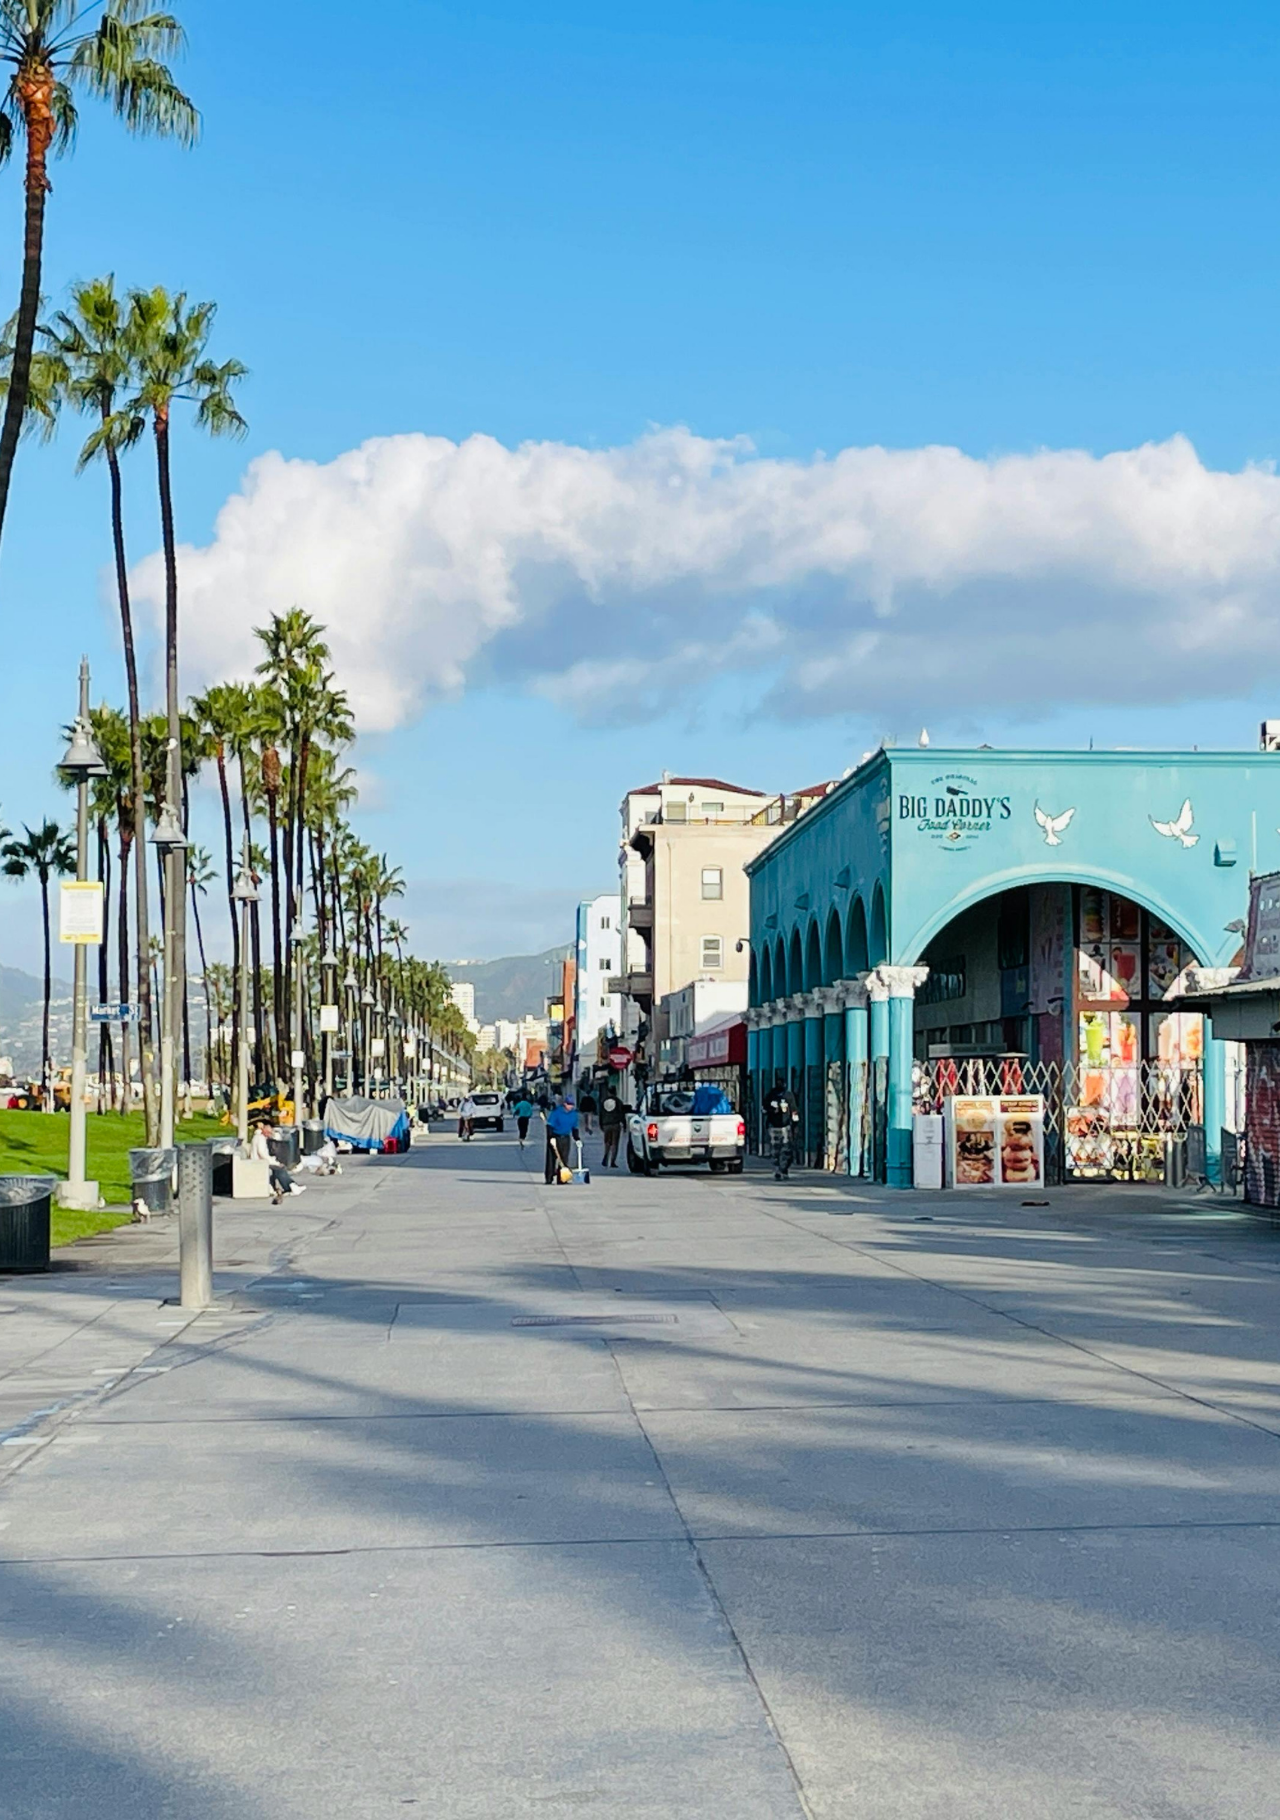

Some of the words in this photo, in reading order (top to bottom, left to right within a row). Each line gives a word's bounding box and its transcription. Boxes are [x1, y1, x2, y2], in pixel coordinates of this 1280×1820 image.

[899, 795, 928, 819] BIG
[934, 797, 1012, 820] DADDY'S
[917, 818, 951, 831] Food
[951, 818, 992, 831] Corner
[92, 1004, 120, 1015] Market
